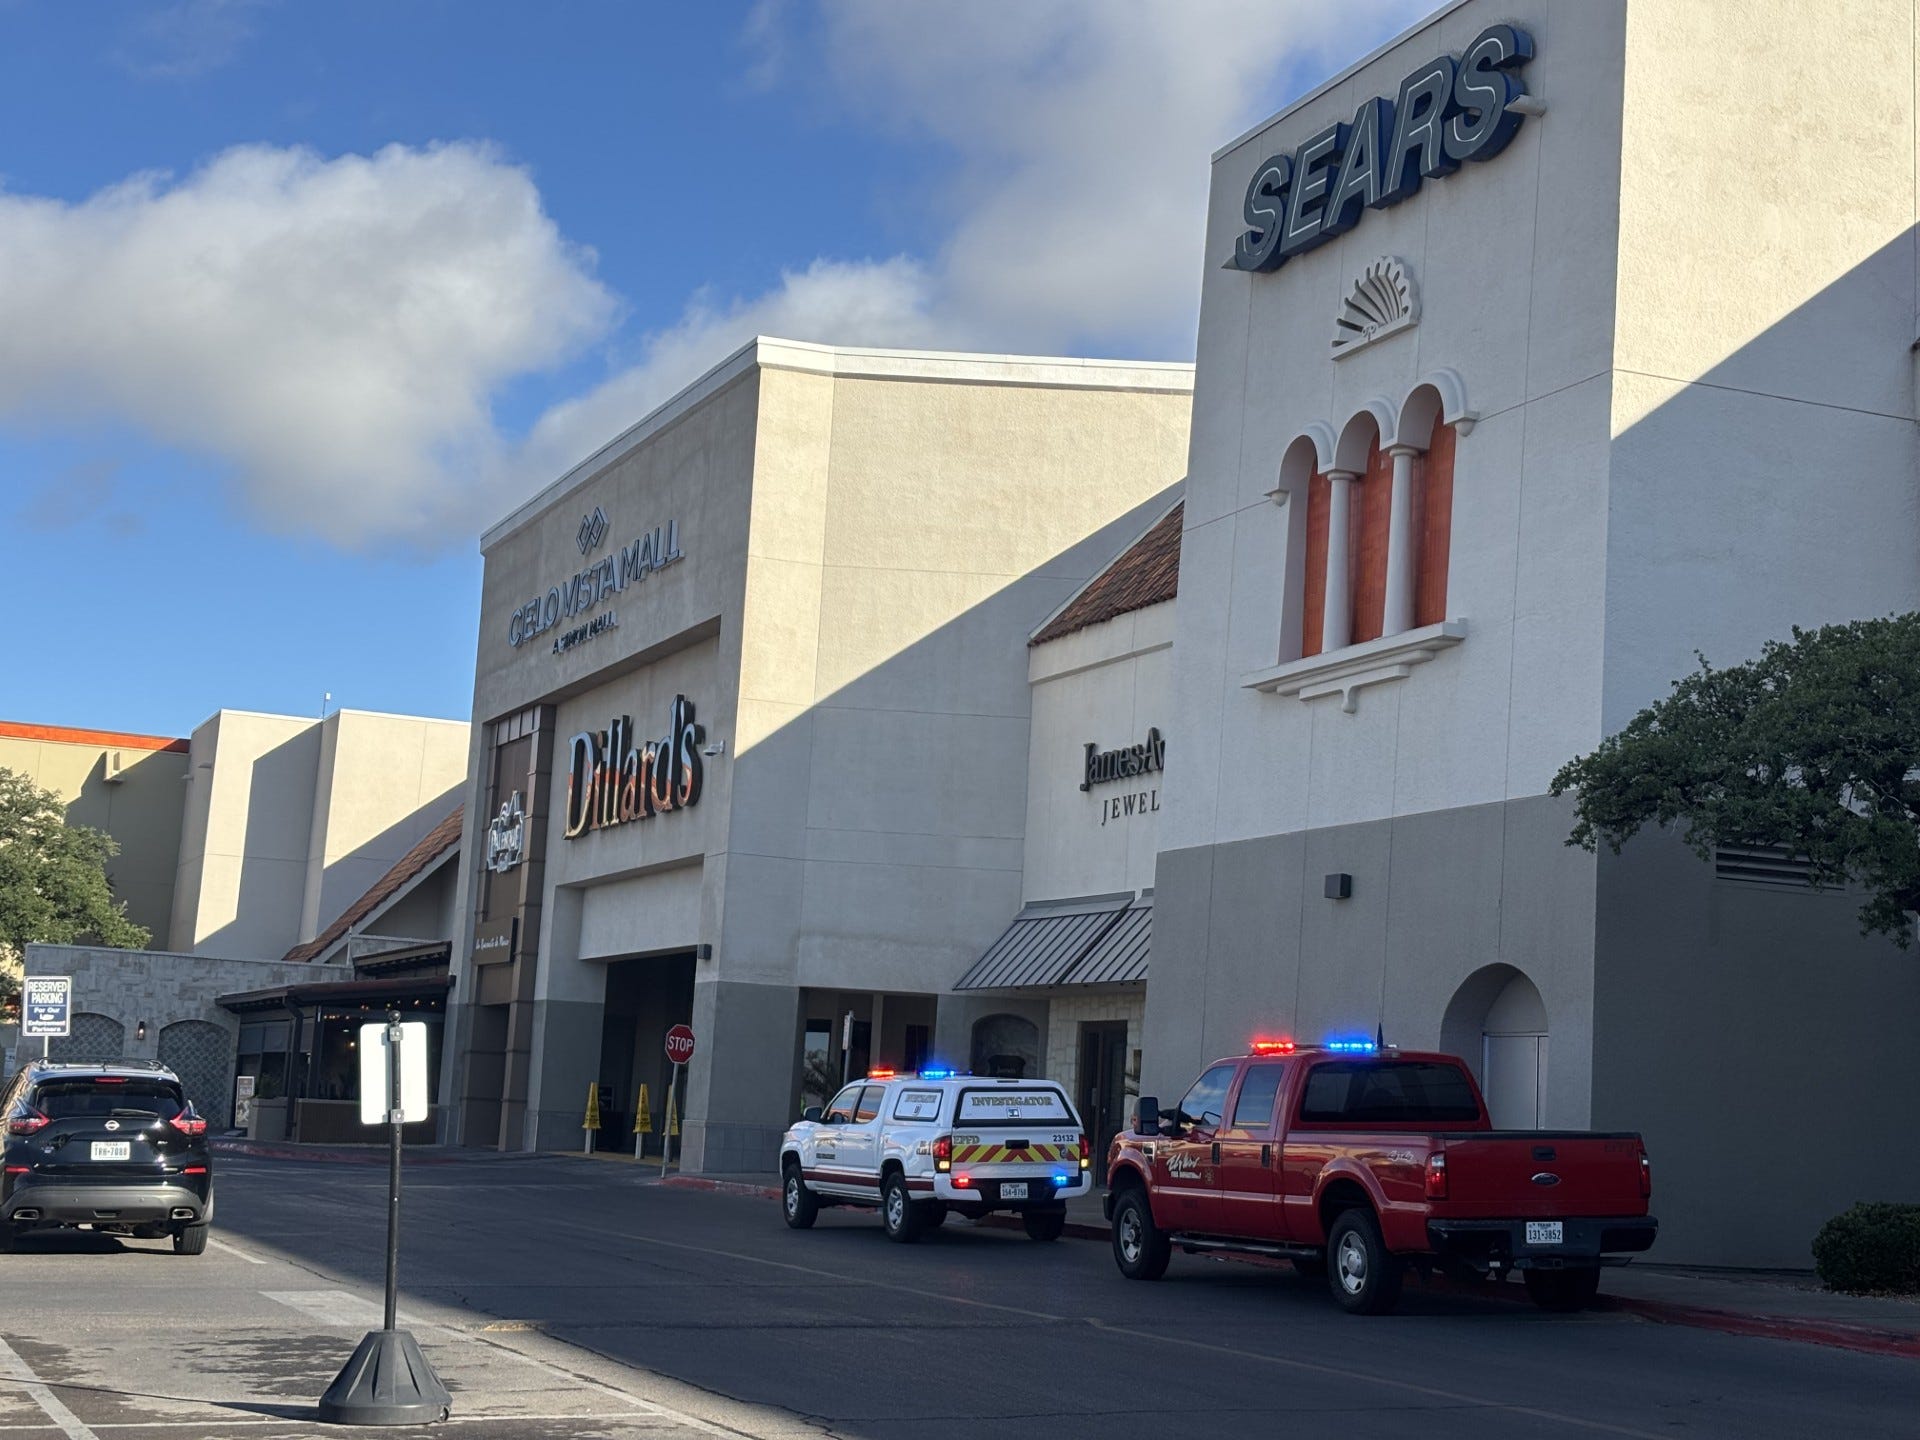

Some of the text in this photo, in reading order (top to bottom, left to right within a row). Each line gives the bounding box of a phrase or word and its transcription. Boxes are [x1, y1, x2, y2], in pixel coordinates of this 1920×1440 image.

[1235, 24, 1533, 271] SEARS
[562, 554, 621, 618] VISTA
[619, 519, 684, 590] MALL
[552, 638, 560, 655] A
[589, 610, 618, 637] MALL
[563, 694, 705, 840] Dillard's
[1101, 790, 1160, 826] JEWEL
[28, 981, 68, 993] RESERVED
[31, 992, 64, 1004] PARKING
[667, 1035, 694, 1052] STOP
[971, 1096, 1053, 1107] INVESTIGATOR
[1053, 1134, 1074, 1142] 23132
